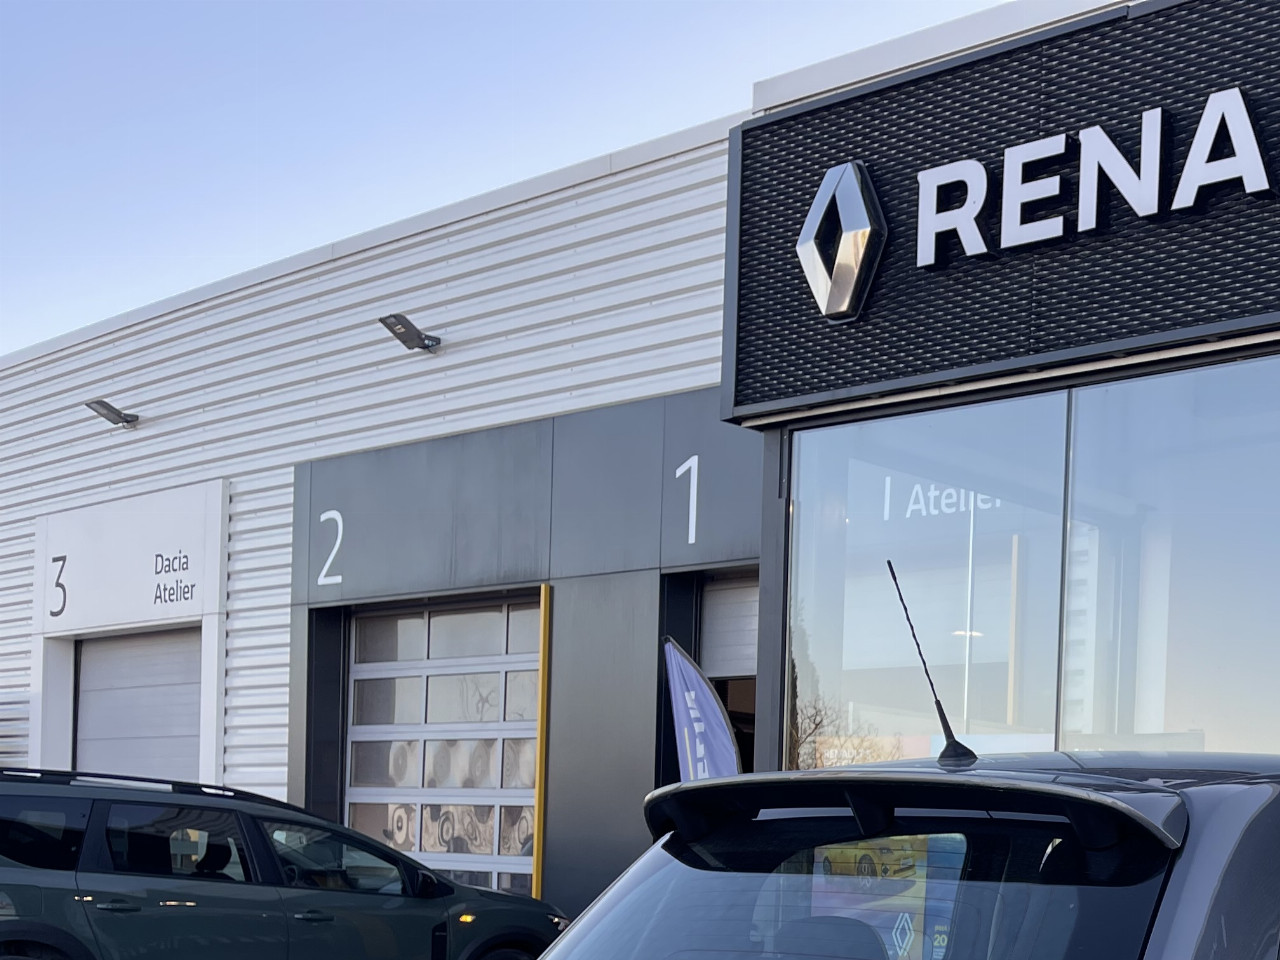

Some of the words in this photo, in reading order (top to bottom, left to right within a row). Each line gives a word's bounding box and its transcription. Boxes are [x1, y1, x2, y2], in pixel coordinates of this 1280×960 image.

[675, 454, 699, 545] 1
[153, 549, 189, 575] Dacia
[317, 509, 344, 586] 2
[50, 555, 67, 618] 3
[153, 579, 196, 605] Atelier
